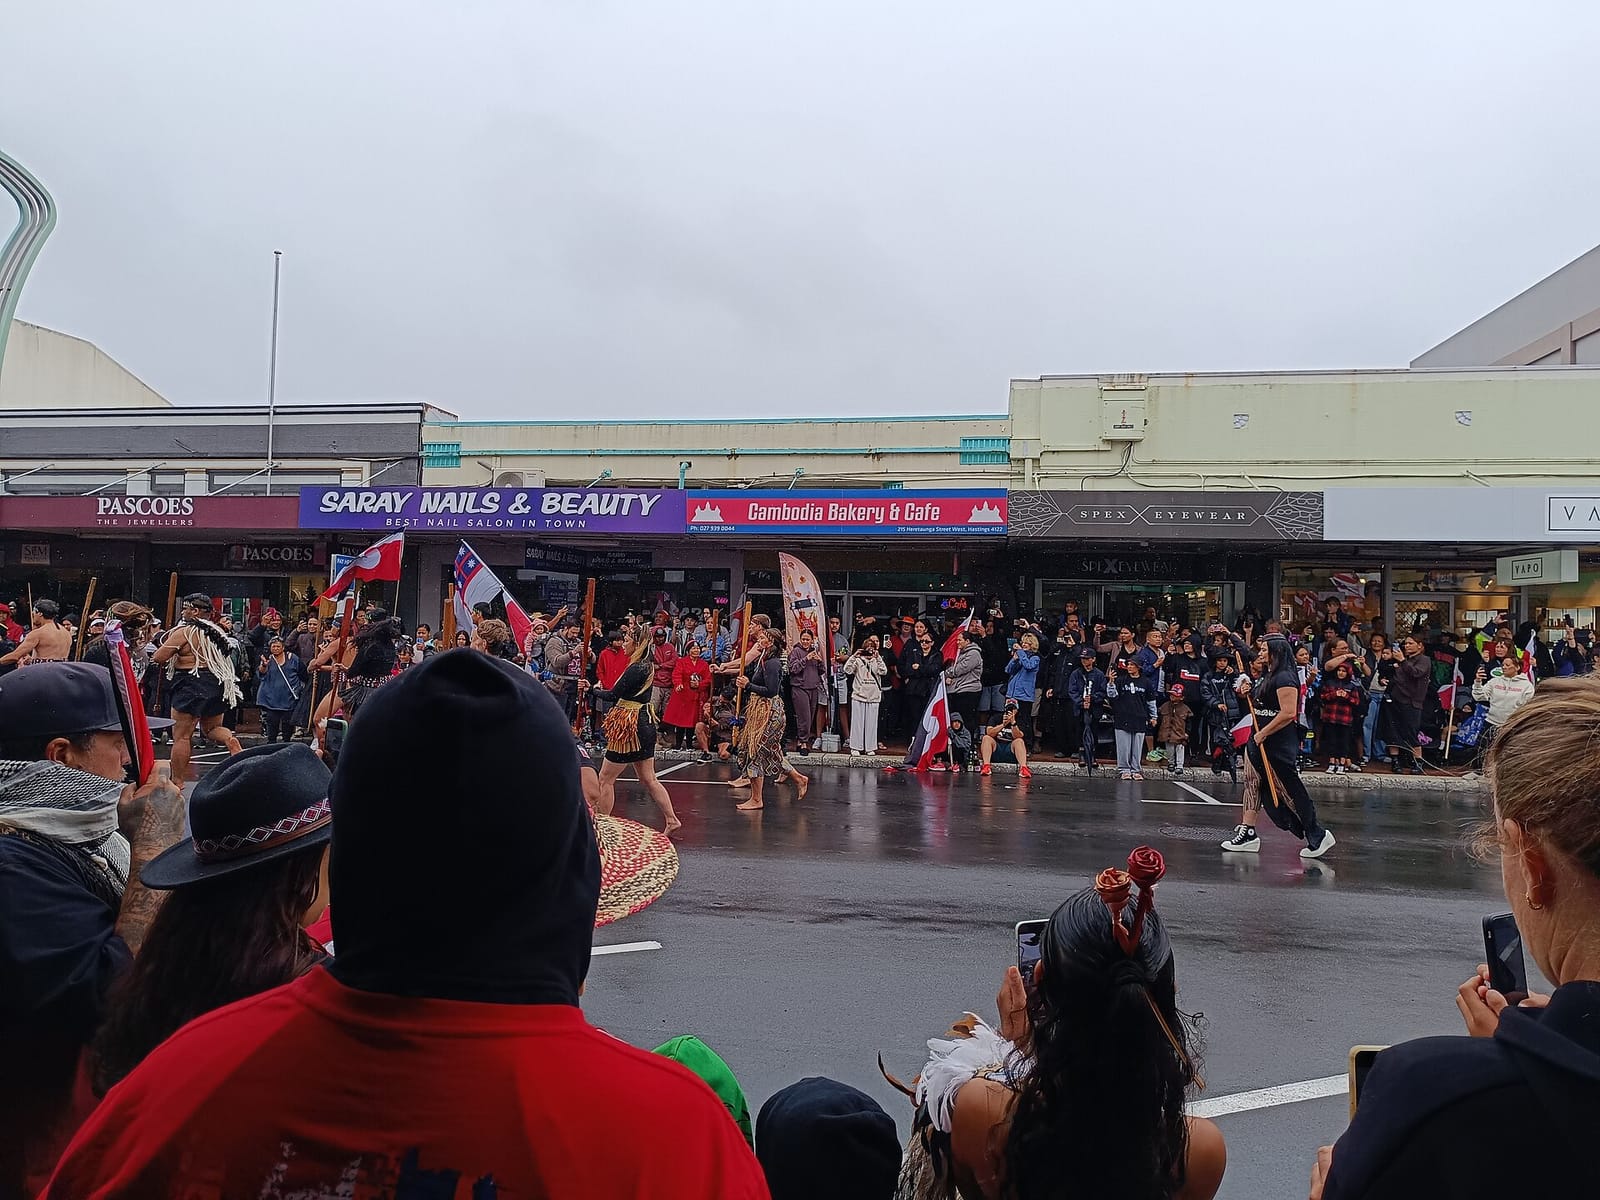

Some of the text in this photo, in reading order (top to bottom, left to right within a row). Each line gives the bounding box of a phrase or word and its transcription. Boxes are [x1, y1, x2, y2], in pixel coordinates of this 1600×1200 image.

[96, 497, 194, 516] PASCOES
[319, 491, 662, 517] SARAY NAILS & BEAUTY
[747, 502, 940, 524] Cambodia Bakery & Cafe
[1080, 510, 1246, 521] SPEX EYEWEAR
[385, 518, 587, 528] BEST NAIL SALON IN TOWN
[242, 546, 313, 562] PASCOES
[1515, 563, 1539, 575] VAPO
